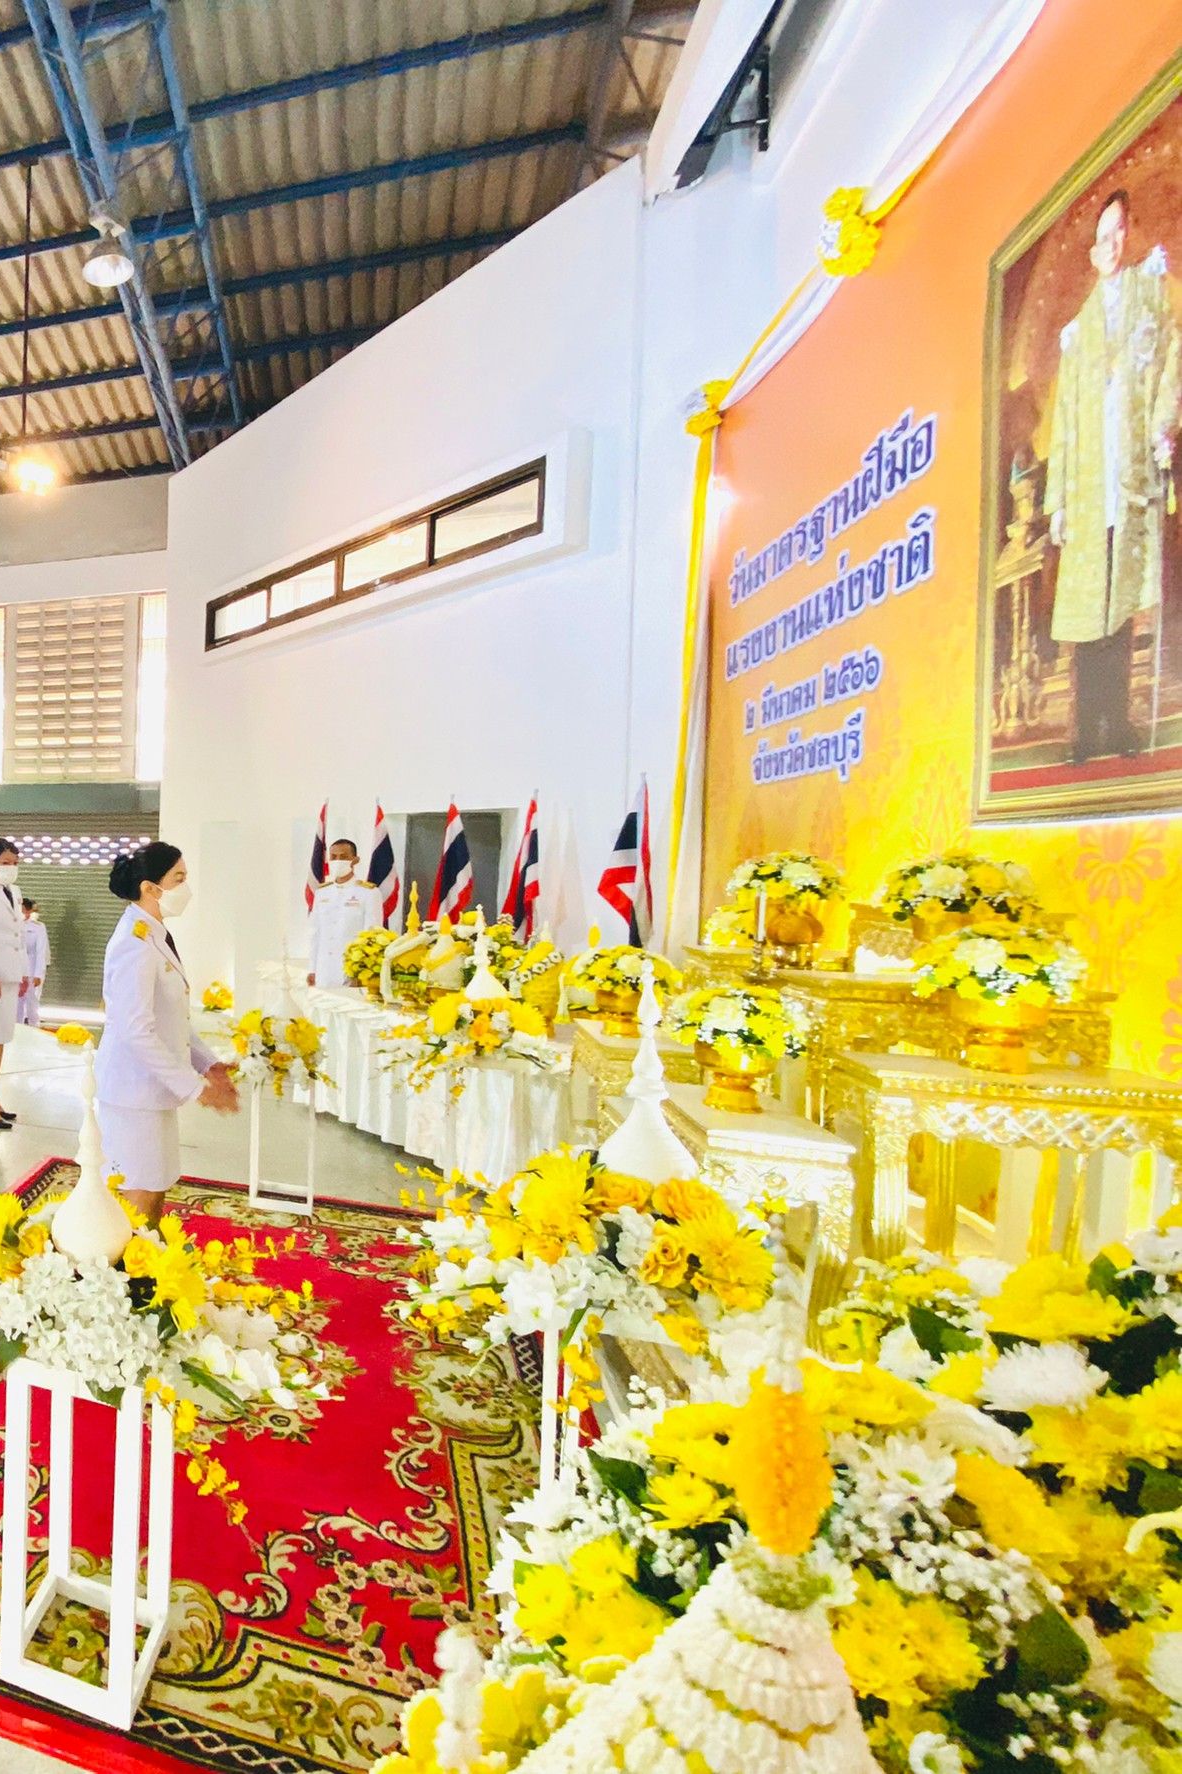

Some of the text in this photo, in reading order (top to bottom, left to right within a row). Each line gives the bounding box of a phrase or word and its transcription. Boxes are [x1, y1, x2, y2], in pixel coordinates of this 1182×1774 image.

[730, 412, 935, 603] วันมาตรฐานฝีมือ
[727, 515, 933, 676] แรงงานแห่งชาติ
[745, 651, 880, 730] ๒ มีนาคม ๒๕๖๖
[753, 715, 863, 778] จังหวัดชลบุรี
